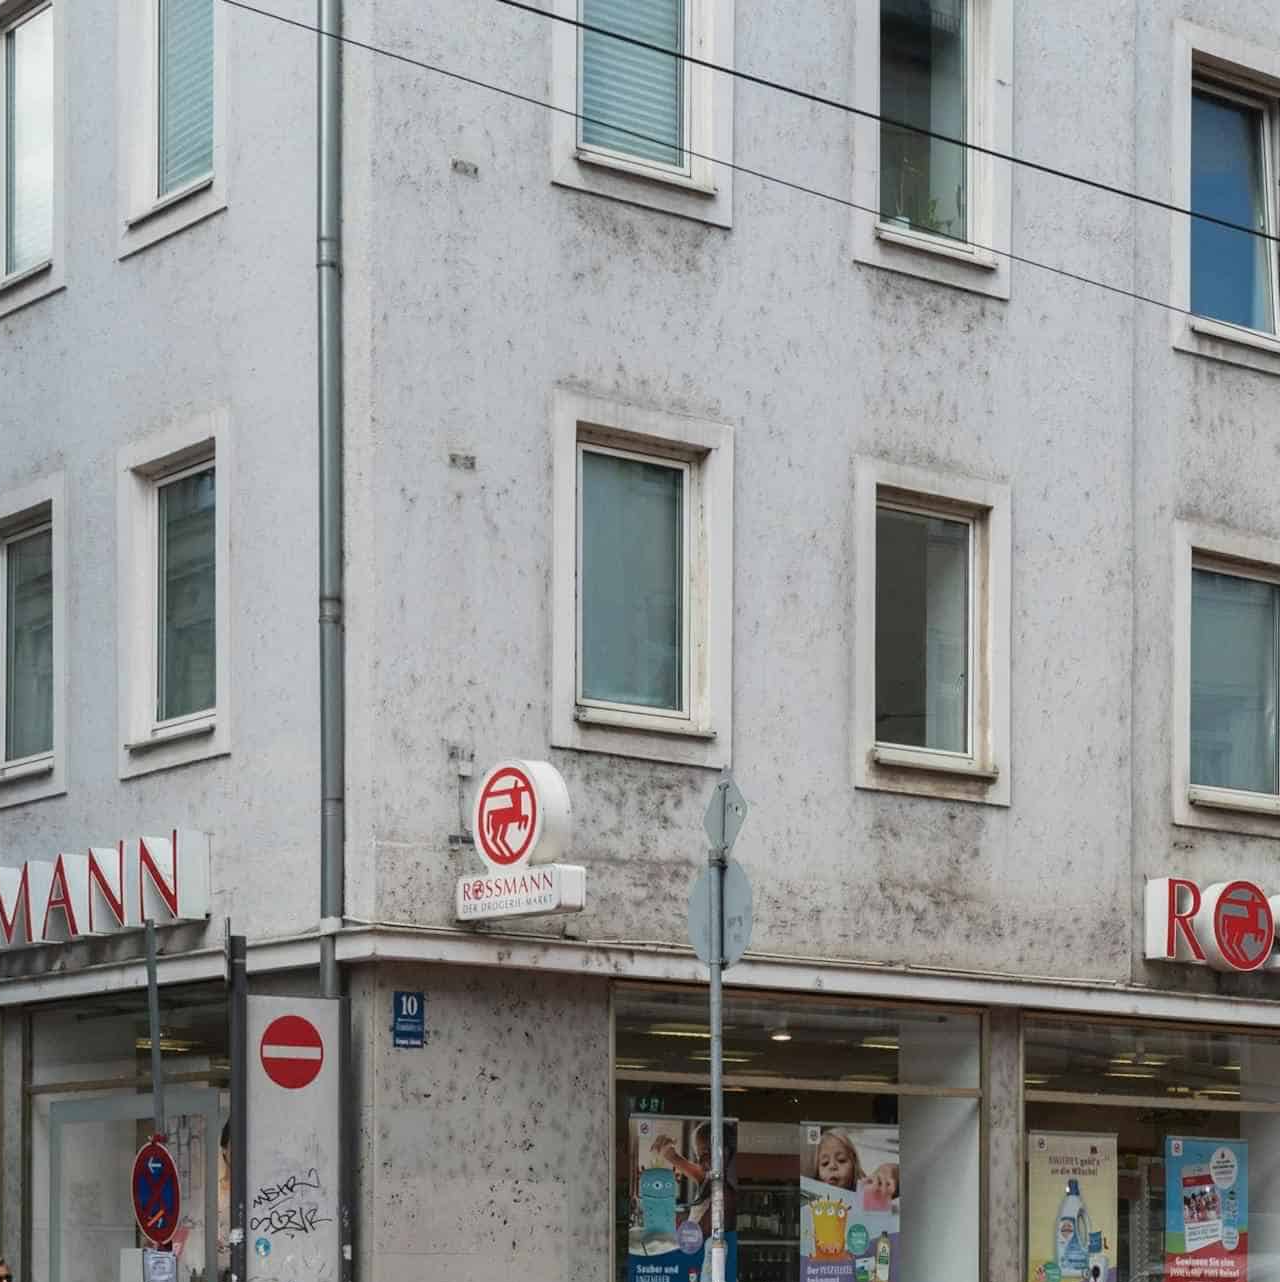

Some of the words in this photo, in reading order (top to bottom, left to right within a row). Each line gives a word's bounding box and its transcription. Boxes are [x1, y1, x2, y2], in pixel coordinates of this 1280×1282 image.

[464, 871, 553, 901] ROSSMANN
[401, 995, 418, 1016] 10
[636, 1264, 663, 1274] Sauber
[664, 1264, 680, 1275] und
